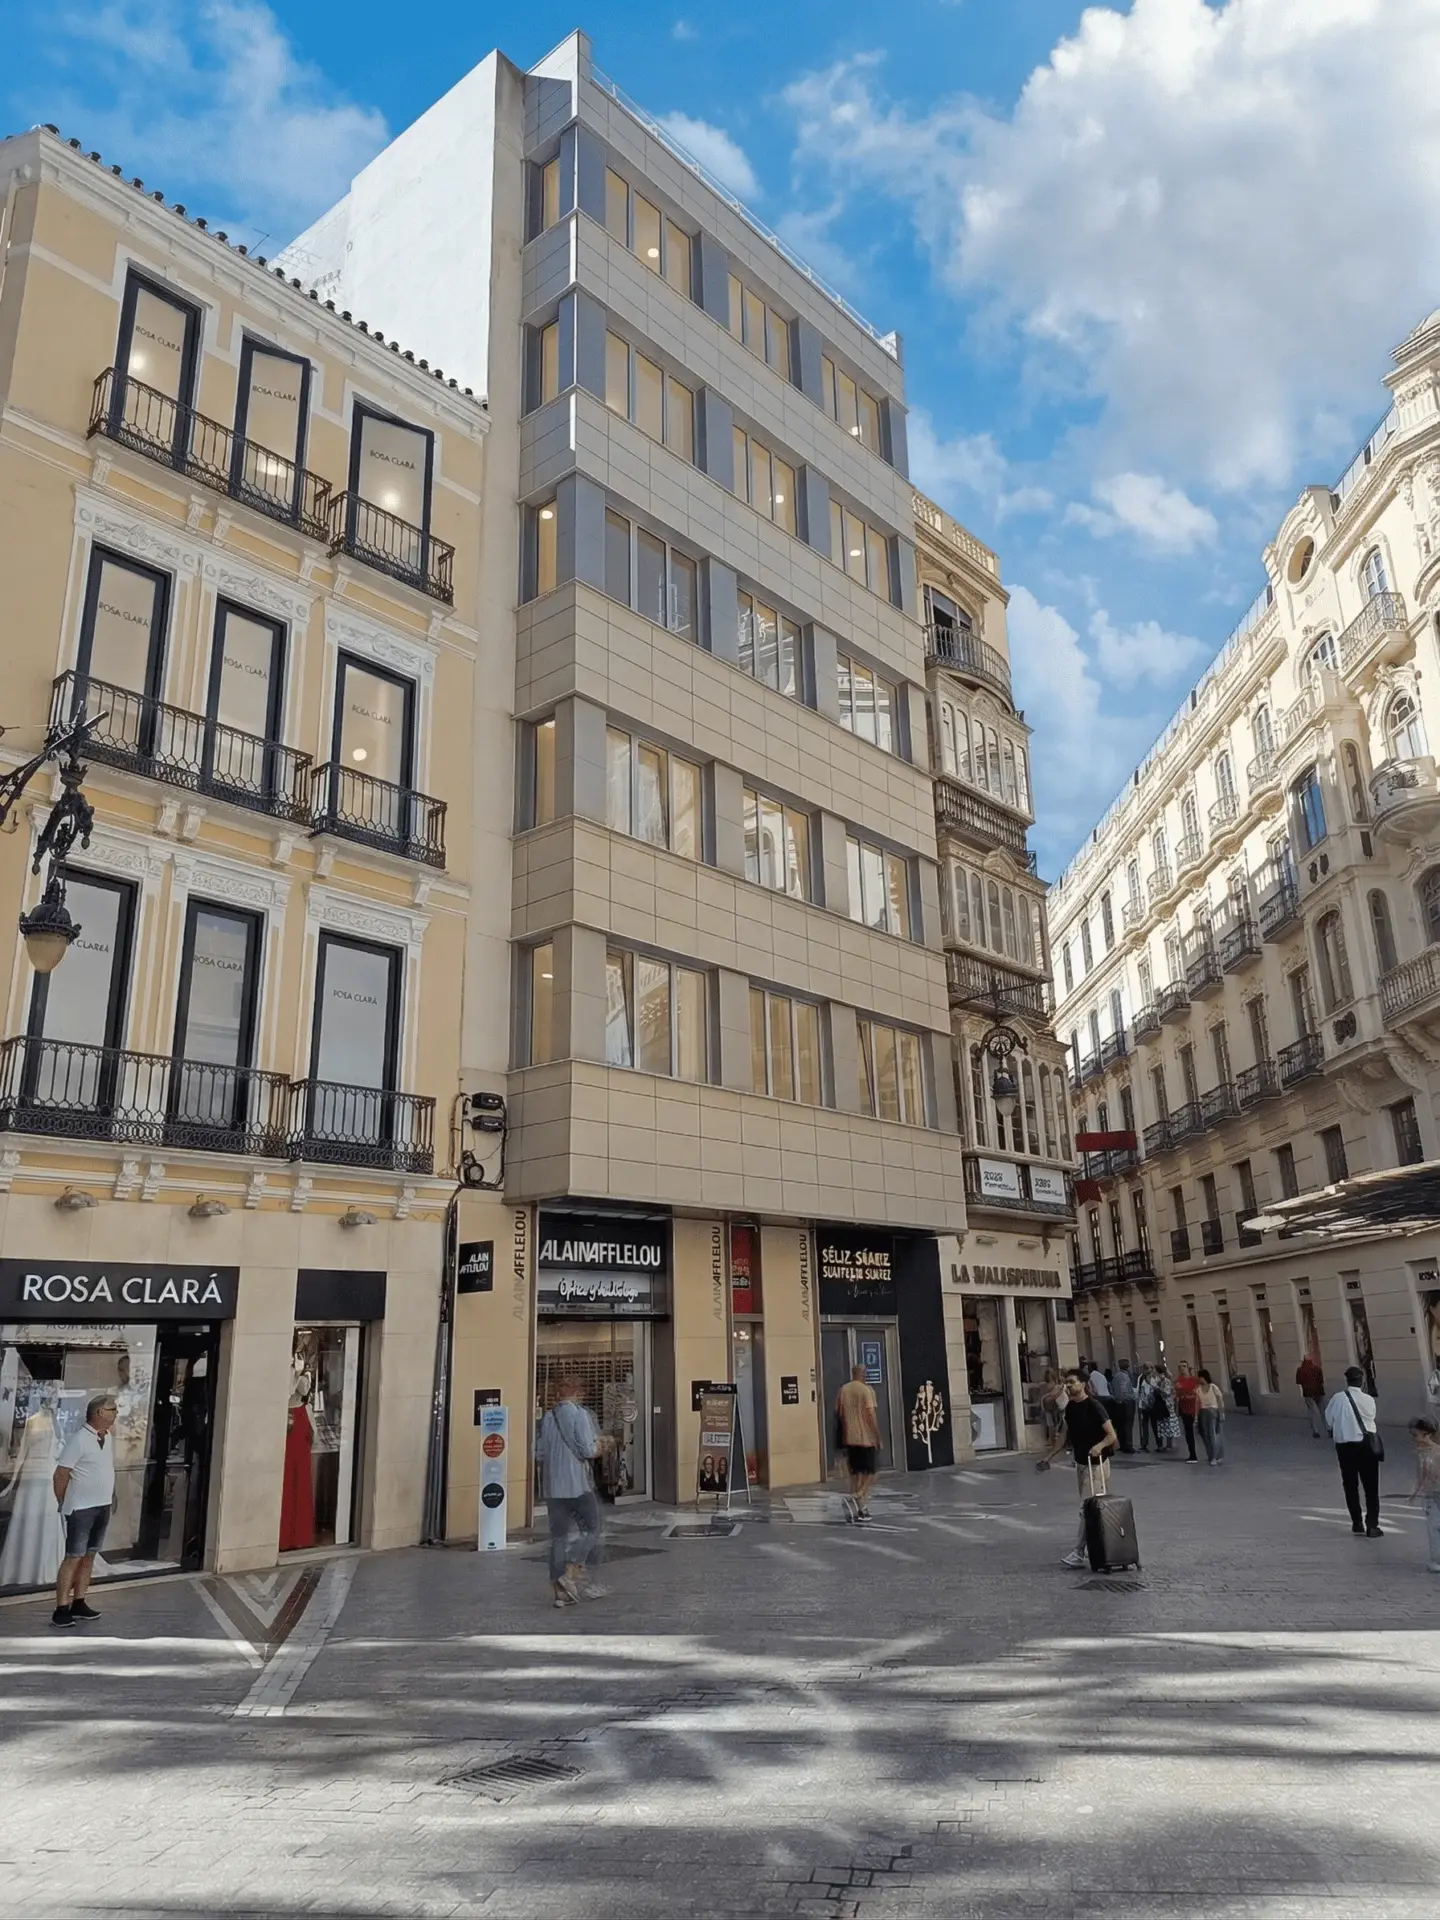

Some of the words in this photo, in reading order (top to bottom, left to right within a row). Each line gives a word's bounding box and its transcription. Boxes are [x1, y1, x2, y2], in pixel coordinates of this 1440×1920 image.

[951, 1263, 971, 1285] LA
[23, 1274, 114, 1303] ROSA
[121, 1273, 223, 1304] CLARÁ
